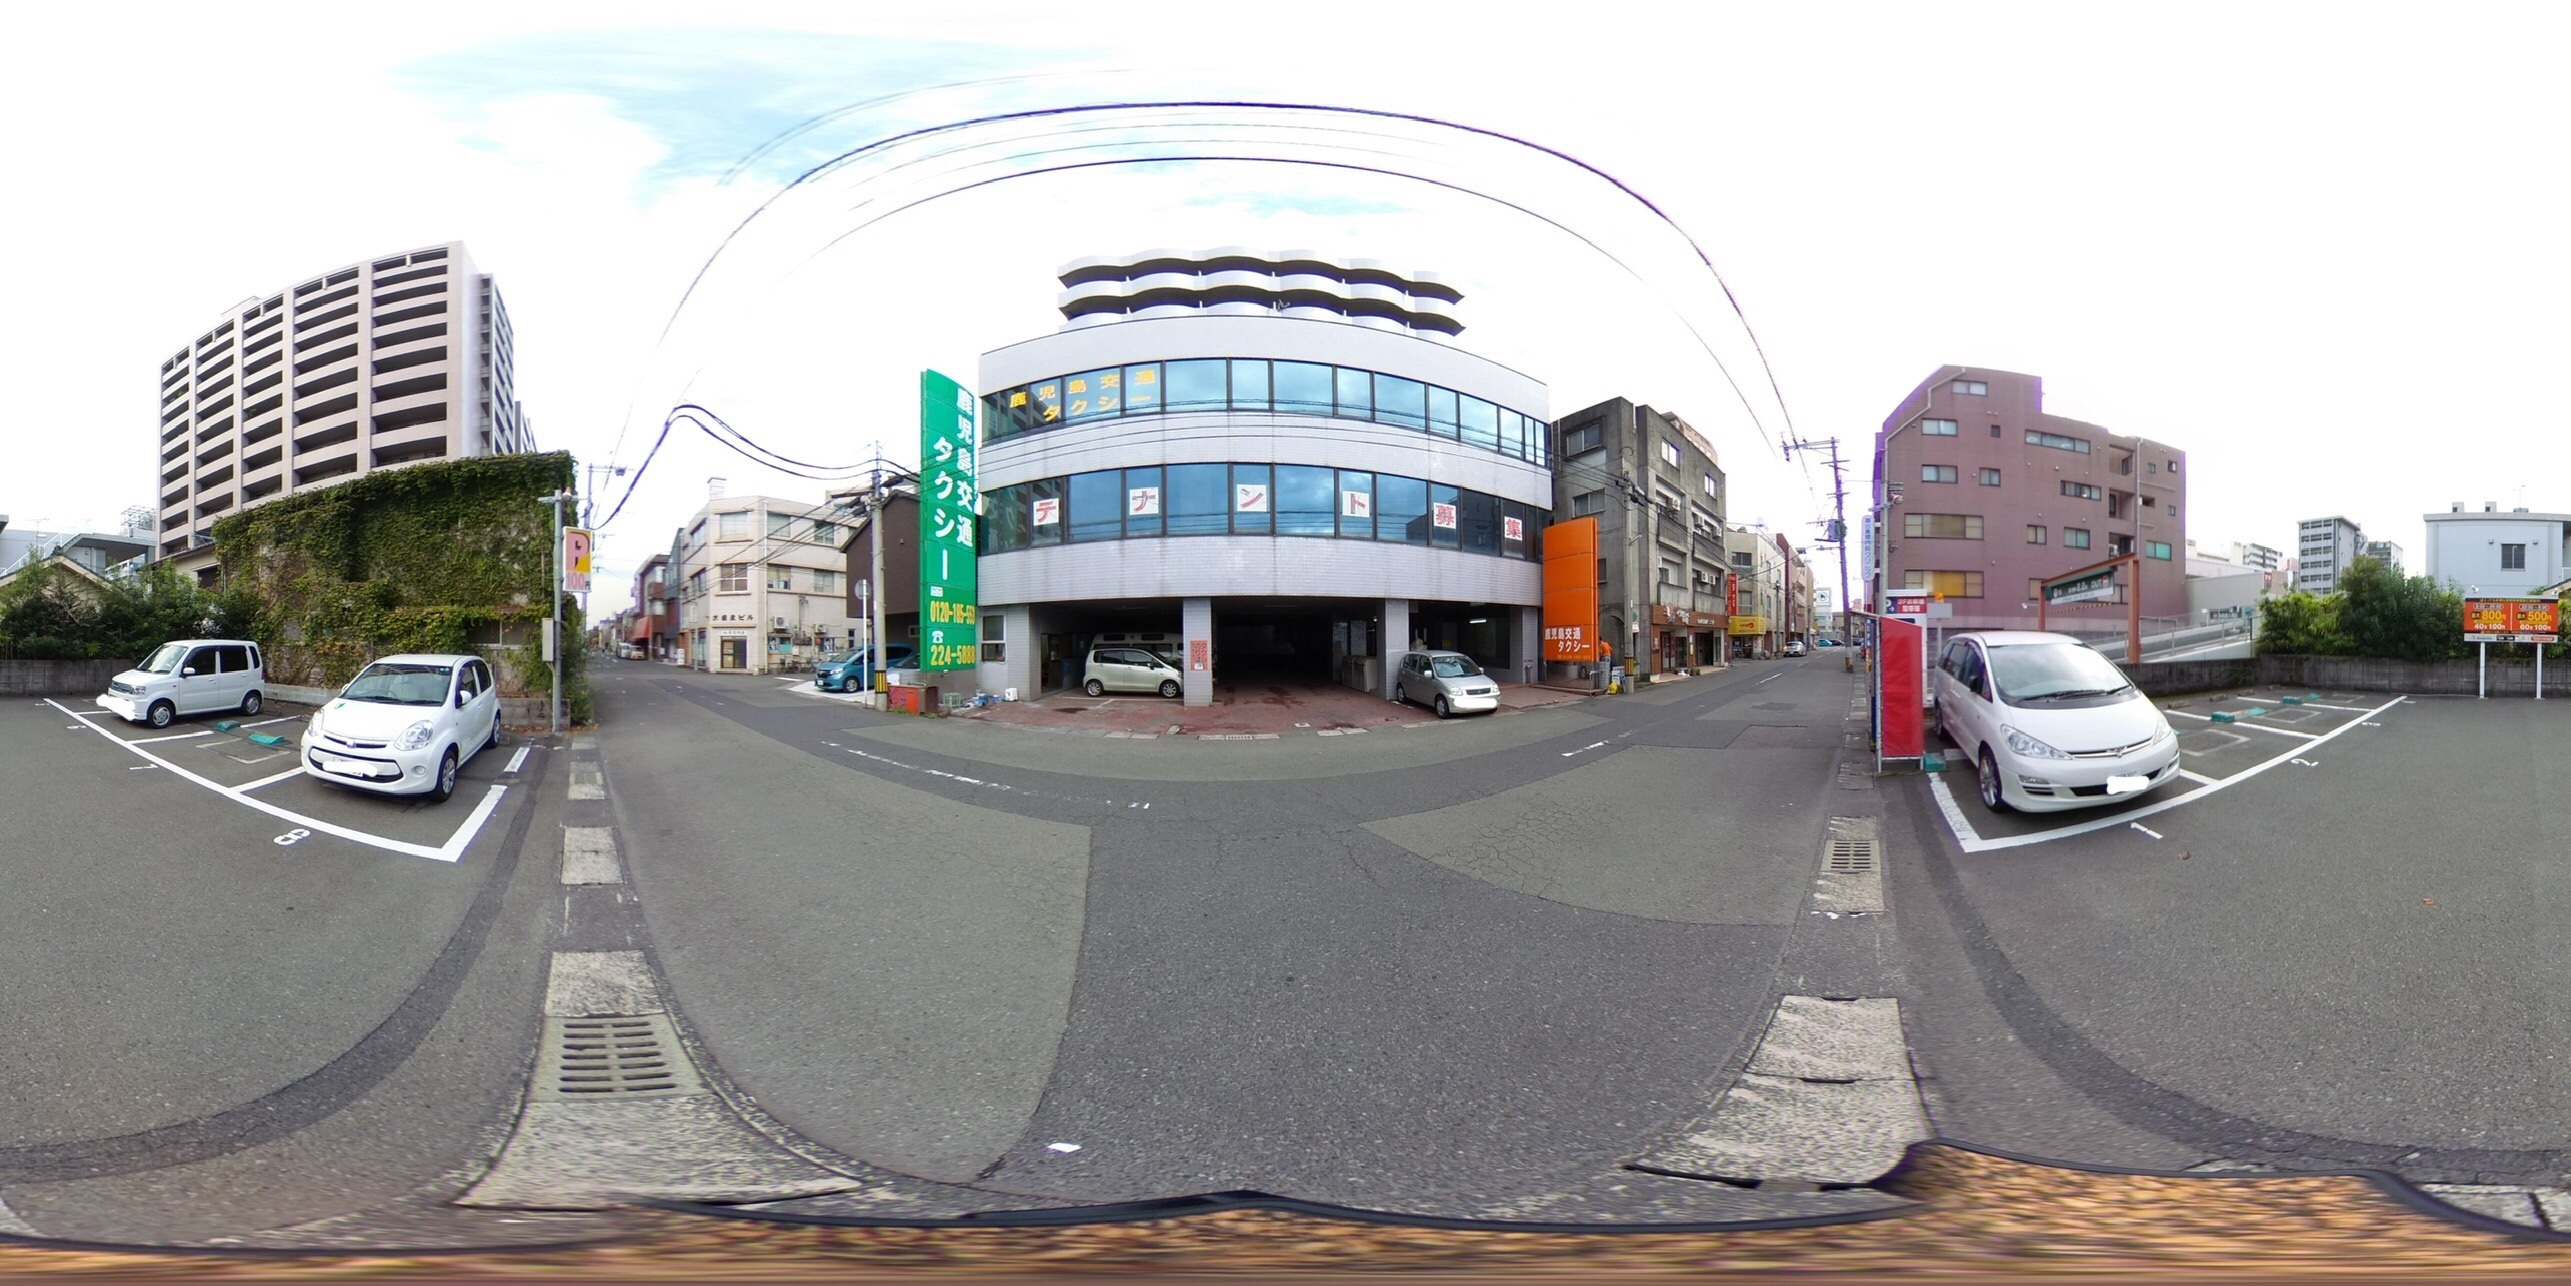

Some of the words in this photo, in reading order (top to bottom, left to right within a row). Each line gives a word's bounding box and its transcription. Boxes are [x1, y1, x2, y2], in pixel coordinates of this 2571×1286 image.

[1010, 370, 1156, 408] 鹿児島交通
[1043, 396, 1152, 421] タクシー
[957, 387, 973, 547] 鹿児島交通
[934, 436, 954, 581] タクシー
[1558, 640, 1590, 652] タクシー
[273, 828, 310, 845] 8
